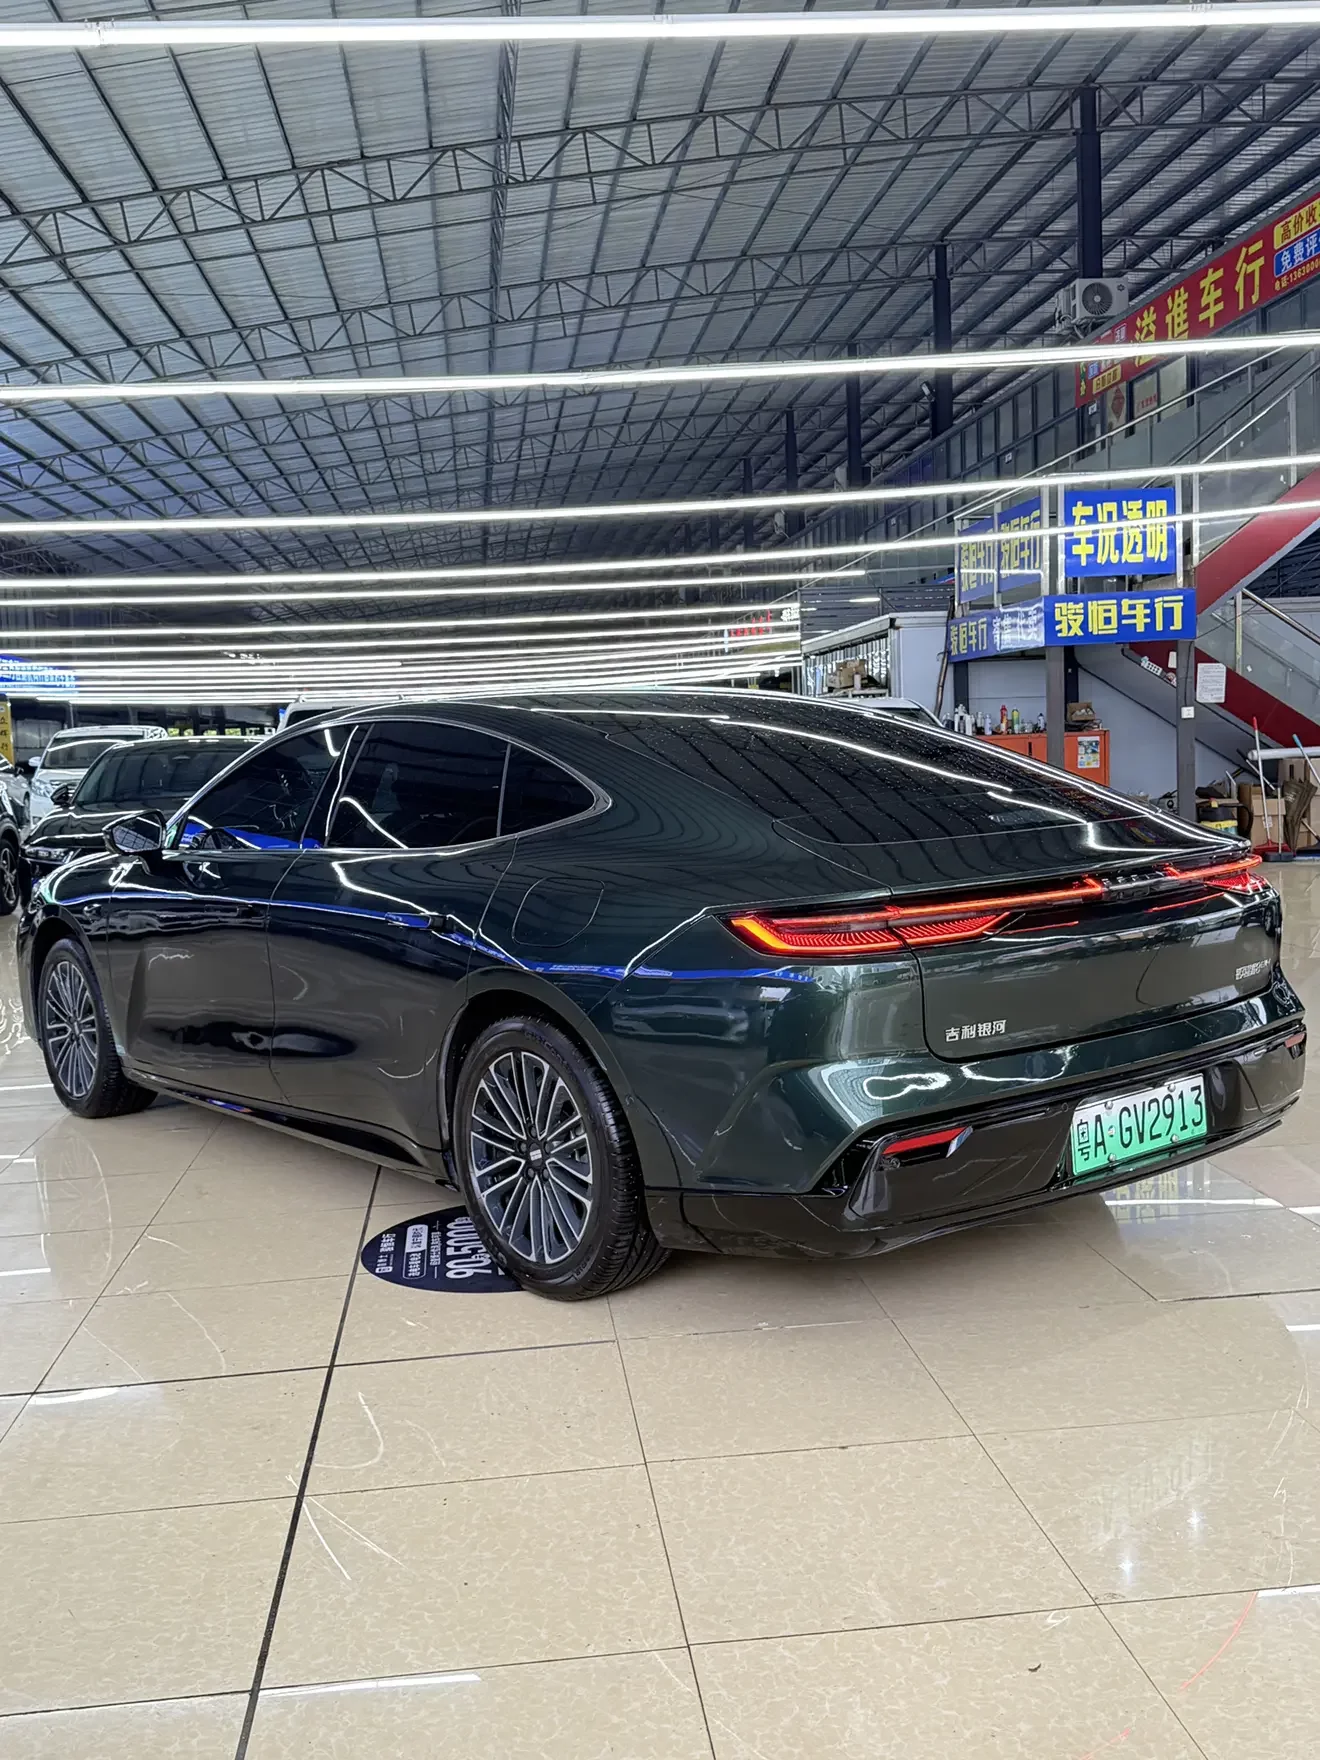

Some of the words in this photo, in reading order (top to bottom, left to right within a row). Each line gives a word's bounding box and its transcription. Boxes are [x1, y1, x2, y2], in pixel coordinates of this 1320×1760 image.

[1281, 203, 1320, 243] 高价收
[1281, 232, 1320, 273] 免费评
[1072, 499, 1167, 566] 车况透明
[1054, 596, 1184, 637] 骏恒车行
[945, 1019, 1007, 1042] 吉利银河
